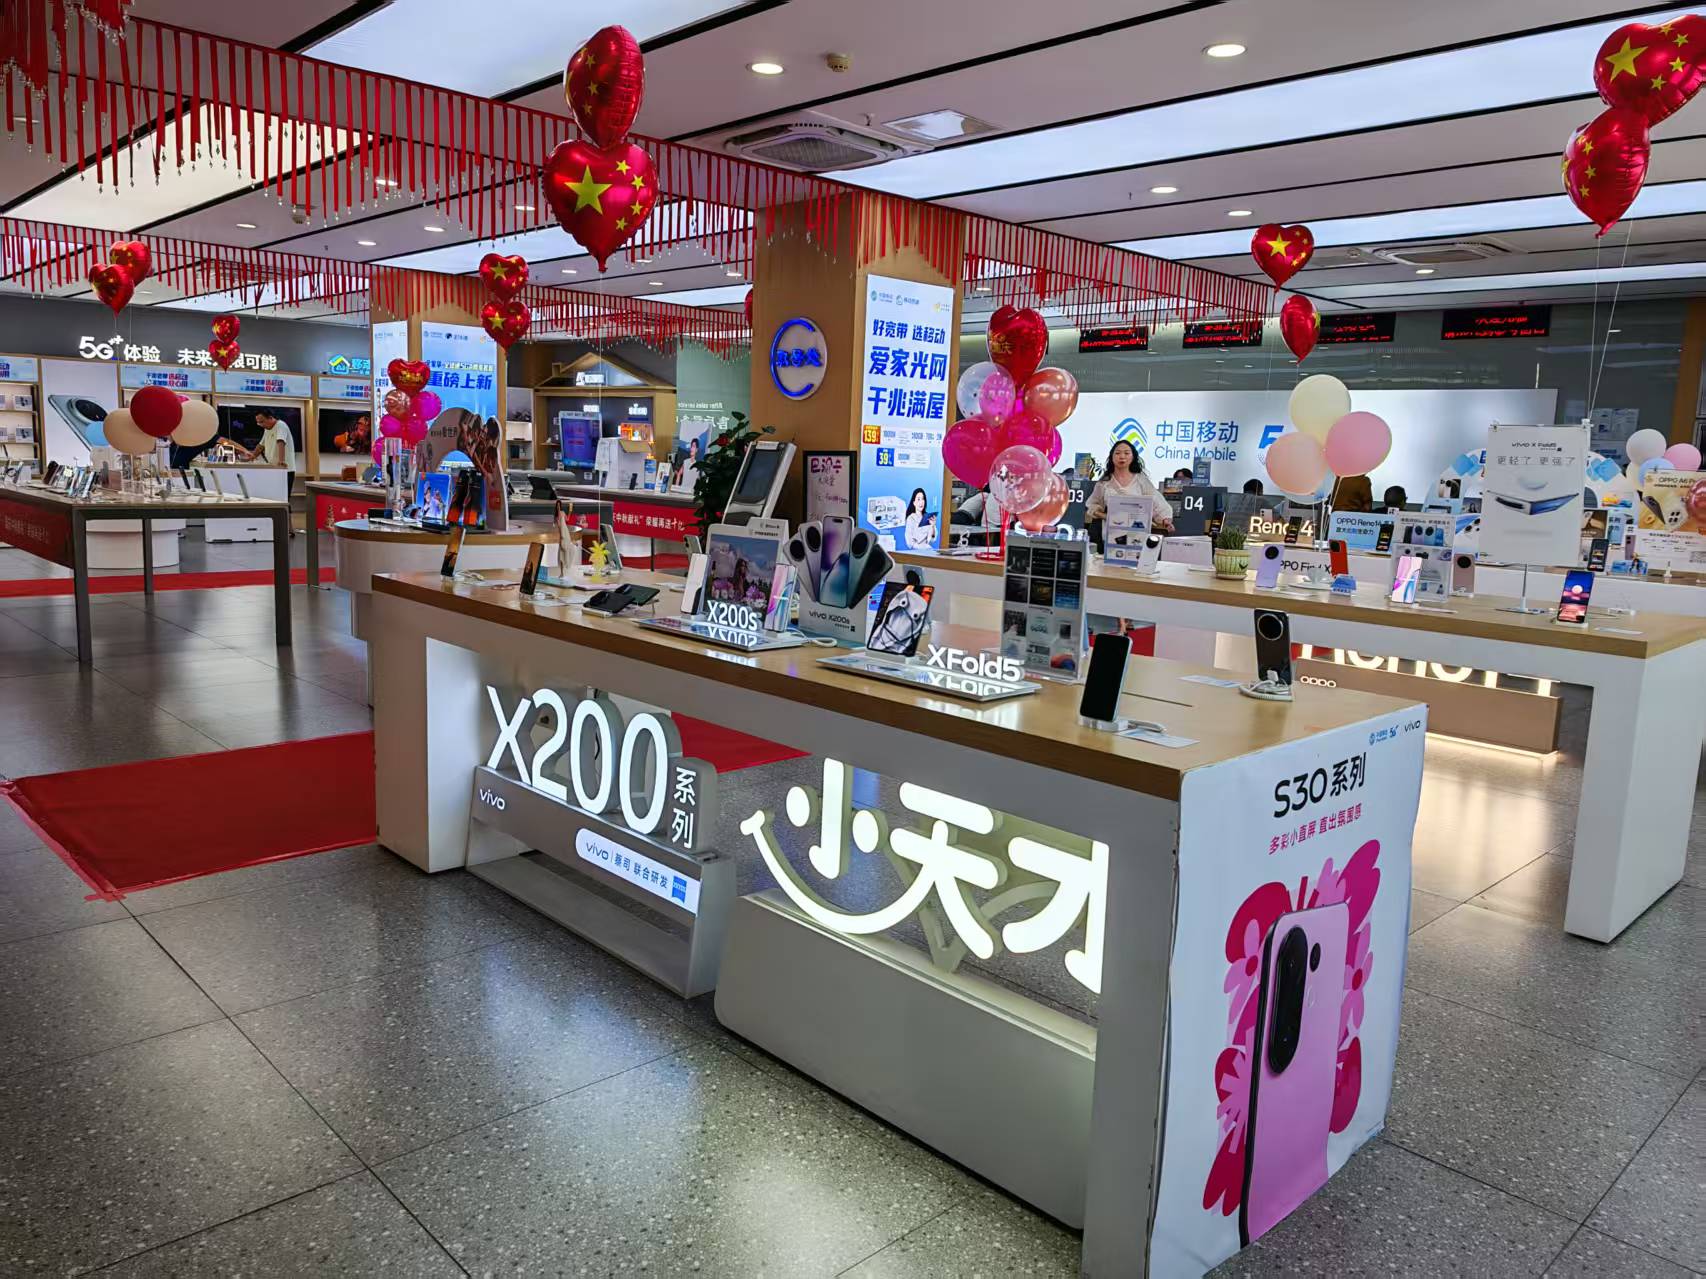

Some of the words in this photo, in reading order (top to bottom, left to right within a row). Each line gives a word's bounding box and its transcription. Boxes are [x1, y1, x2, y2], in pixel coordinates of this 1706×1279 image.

[872, 319, 908, 338] 好宽带
[912, 325, 946, 345] 选移动
[123, 344, 161, 363] 体验
[869, 346, 948, 382] 爱家光网
[427, 371, 493, 391] 重磅上新
[867, 386, 946, 420] 千兆满屋
[863, 429, 877, 443] 139
[1156, 421, 1239, 443] 中国移动
[879, 452, 889, 465] 39
[1155, 446, 1190, 460] China
[1194, 446, 1236, 461] Mobile
[1498, 455, 1532, 466] 更轻了
[1540, 456, 1576, 467] 更强了
[1184, 496, 1204, 511] 04
[1336, 517, 1356, 525] OPPO
[706, 600, 759, 631] X200s
[809, 610, 827, 620] vivo
[926, 643, 1025, 682] XFold5
[1404, 720, 1421, 732] vivo
[486, 685, 668, 835] X200
[1272, 751, 1367, 819] S30系列
[479, 788, 505, 811] vivo
[671, 766, 697, 849] 系列
[1268, 819, 1317, 856] 多彩小直屏
[1318, 802, 1362, 834] 直出氛围感
[586, 841, 610, 861] vivo
[614, 852, 631, 872] 蔡司
[633, 862, 669, 889] 联合研发
[740, 757, 1110, 994] 小天才
